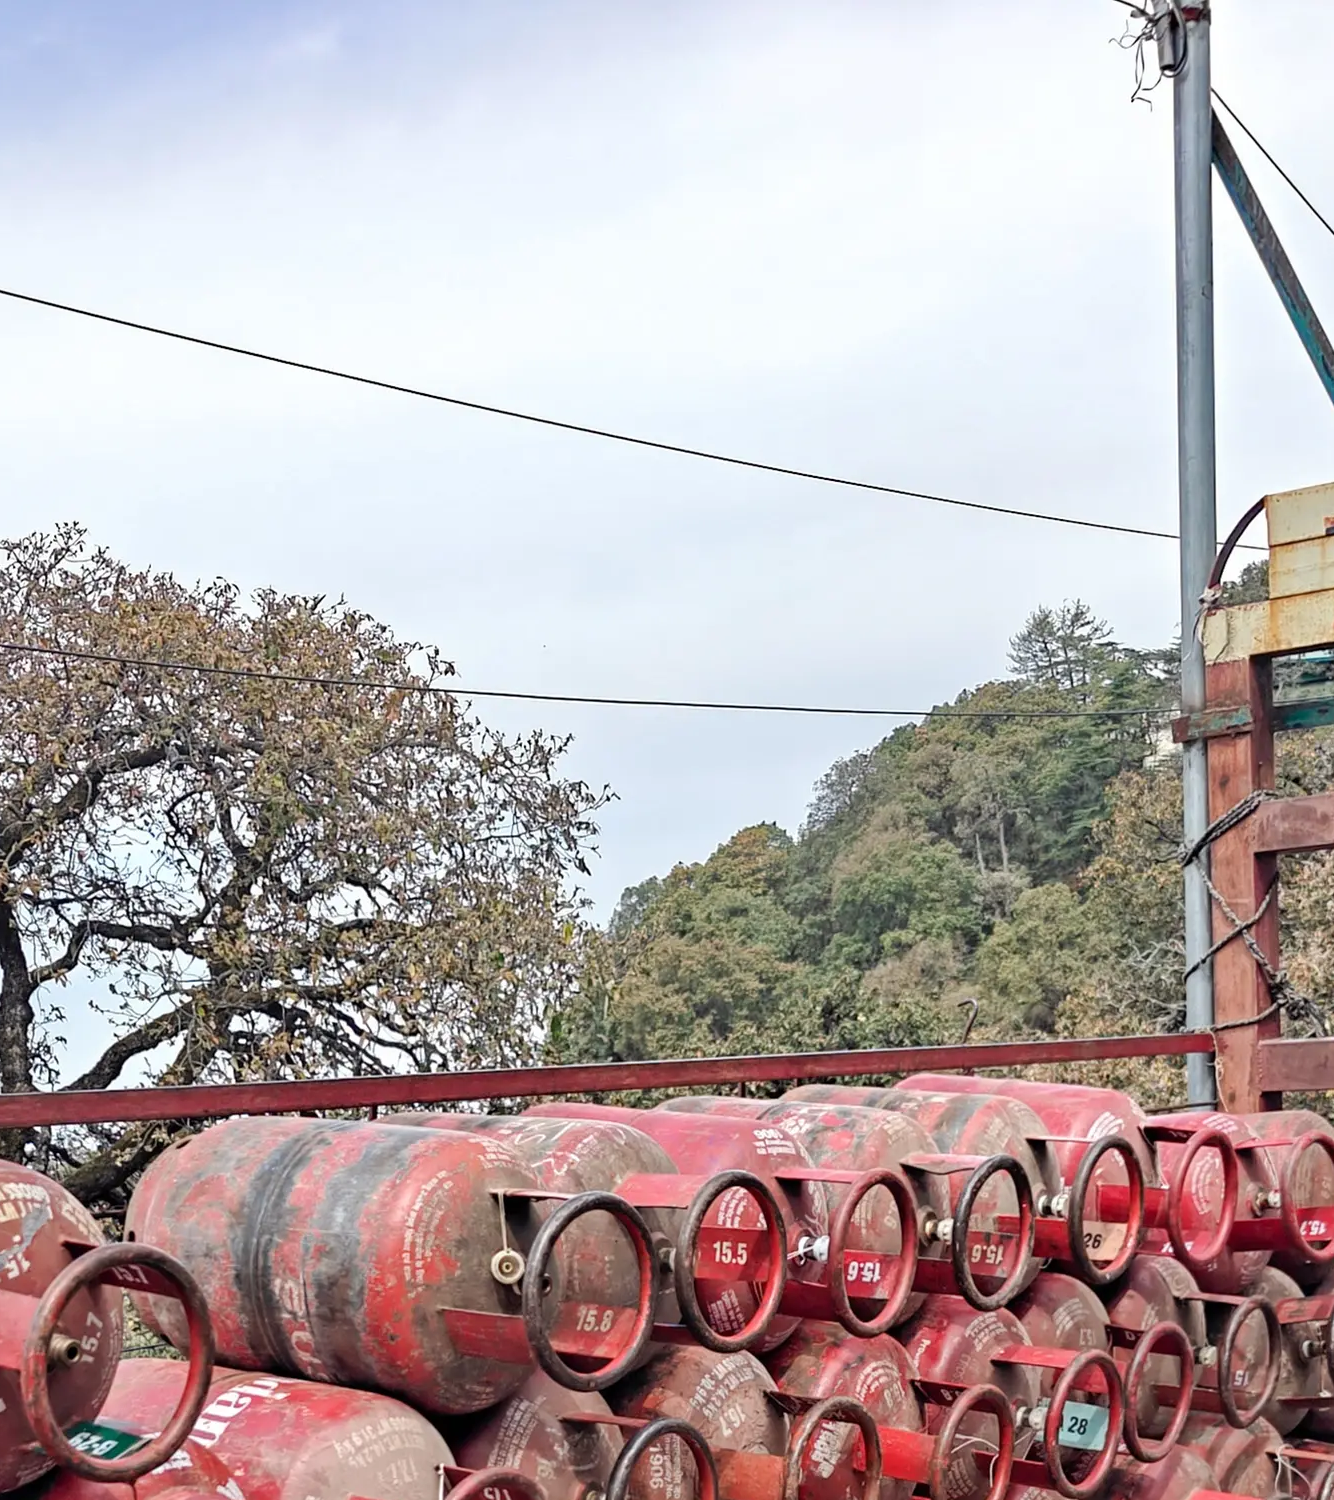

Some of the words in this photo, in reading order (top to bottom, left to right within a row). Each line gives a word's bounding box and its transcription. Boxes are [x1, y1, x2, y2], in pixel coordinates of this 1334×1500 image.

[713, 1241, 748, 1266] 15.5
[971, 1243, 1005, 1263] 15.6
[846, 1260, 882, 1283] 15.6
[576, 1304, 613, 1333] 15.8
[80, 1312, 103, 1363] 15.7
[718, 1403, 745, 1437] 16.7
[648, 1447, 664, 1490] 1906
